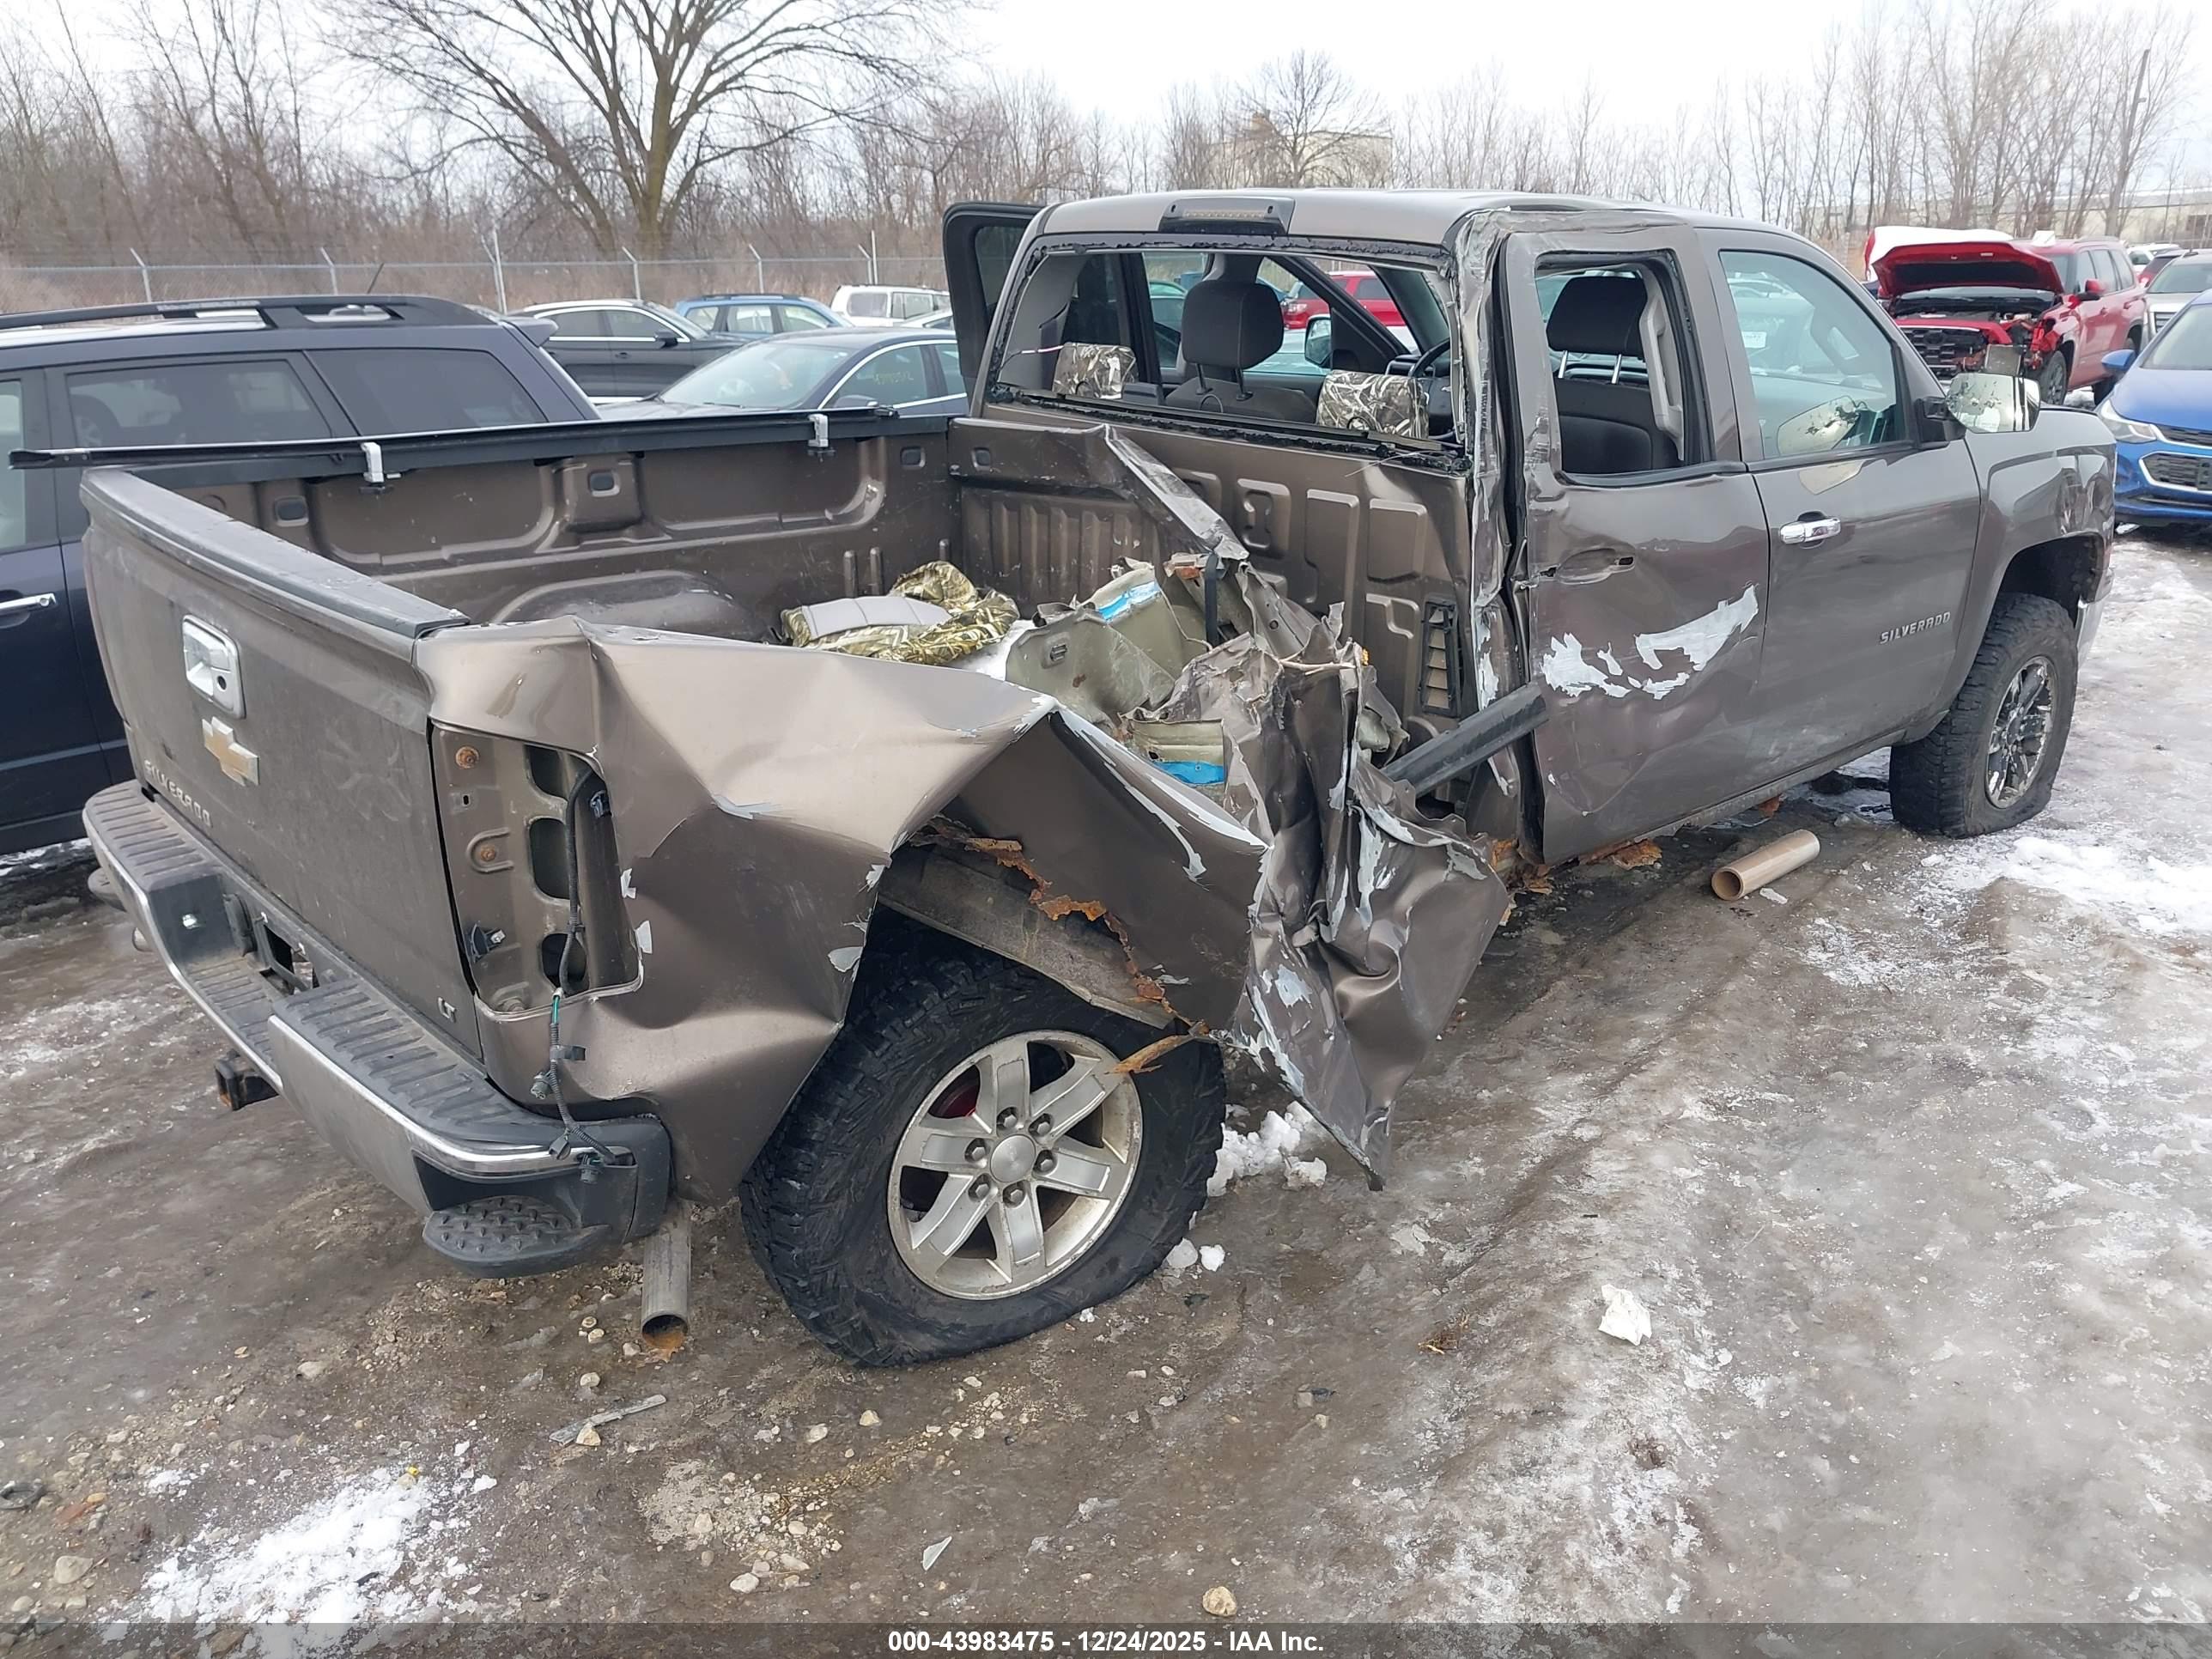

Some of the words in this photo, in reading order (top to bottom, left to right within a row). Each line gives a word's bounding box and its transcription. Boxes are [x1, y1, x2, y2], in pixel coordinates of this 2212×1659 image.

[1880, 611, 1951, 644] SILVERADO
[143, 759, 213, 828] SILVERADO
[438, 996, 456, 1023] LT
